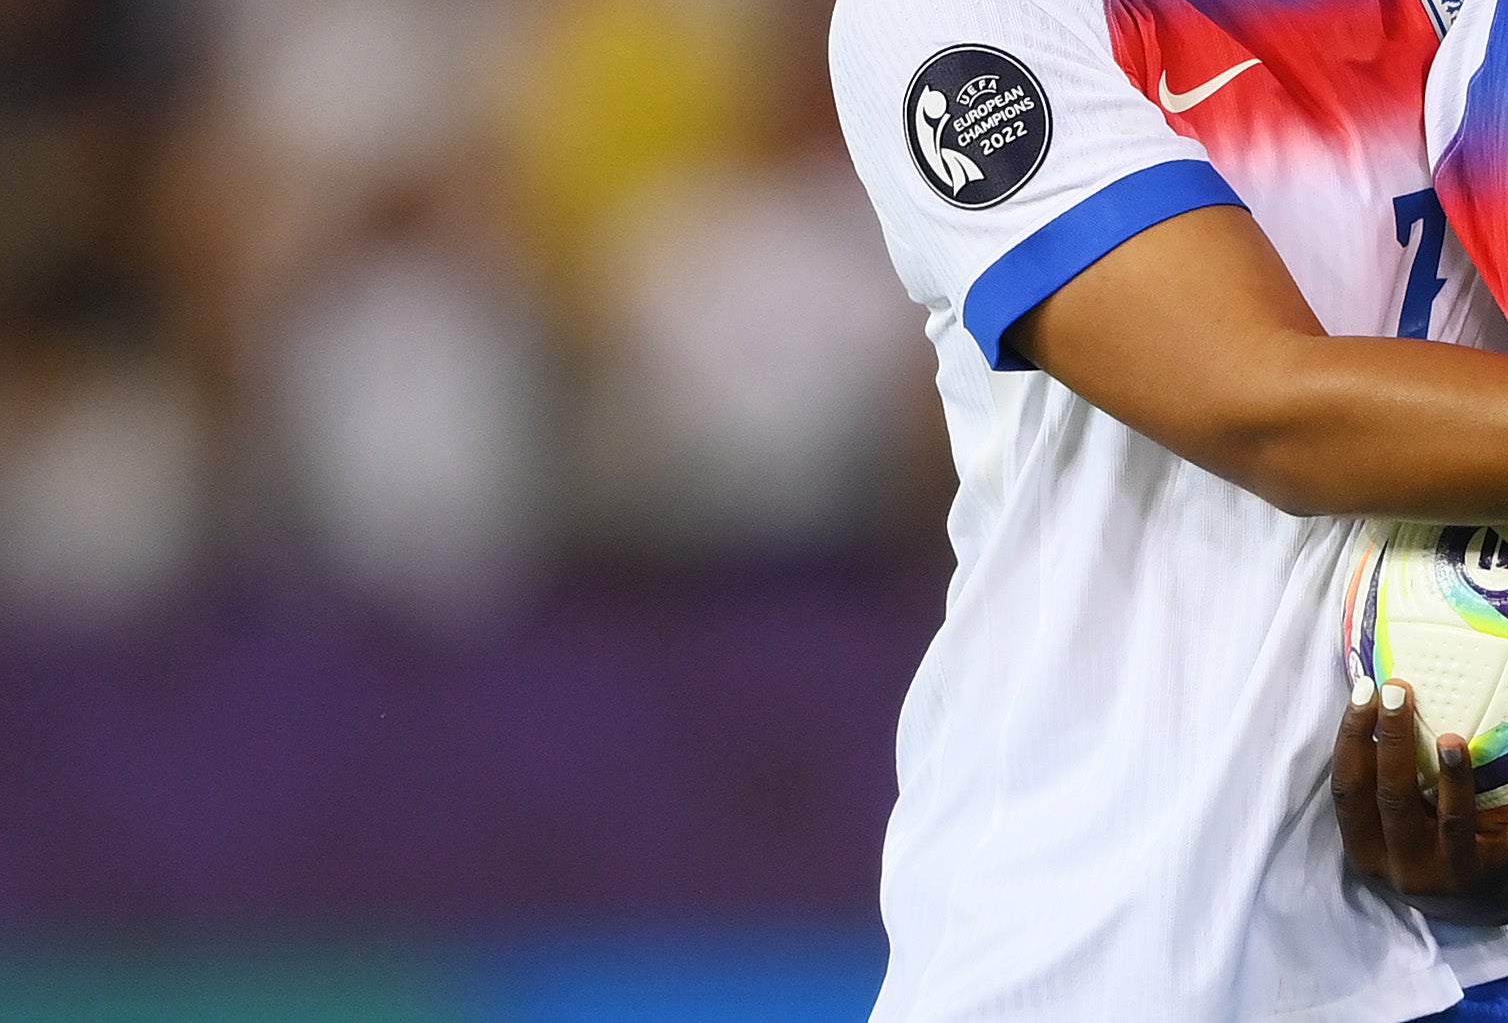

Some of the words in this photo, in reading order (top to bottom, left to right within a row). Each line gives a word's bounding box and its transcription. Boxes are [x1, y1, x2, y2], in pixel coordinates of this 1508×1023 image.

[952, 84, 1025, 132] EUROPEAN
[959, 78, 997, 105] UEFA
[957, 96, 1035, 147] CHAMPIONS
[979, 120, 1028, 156] 2022
[1392, 187, 1447, 340] 7
